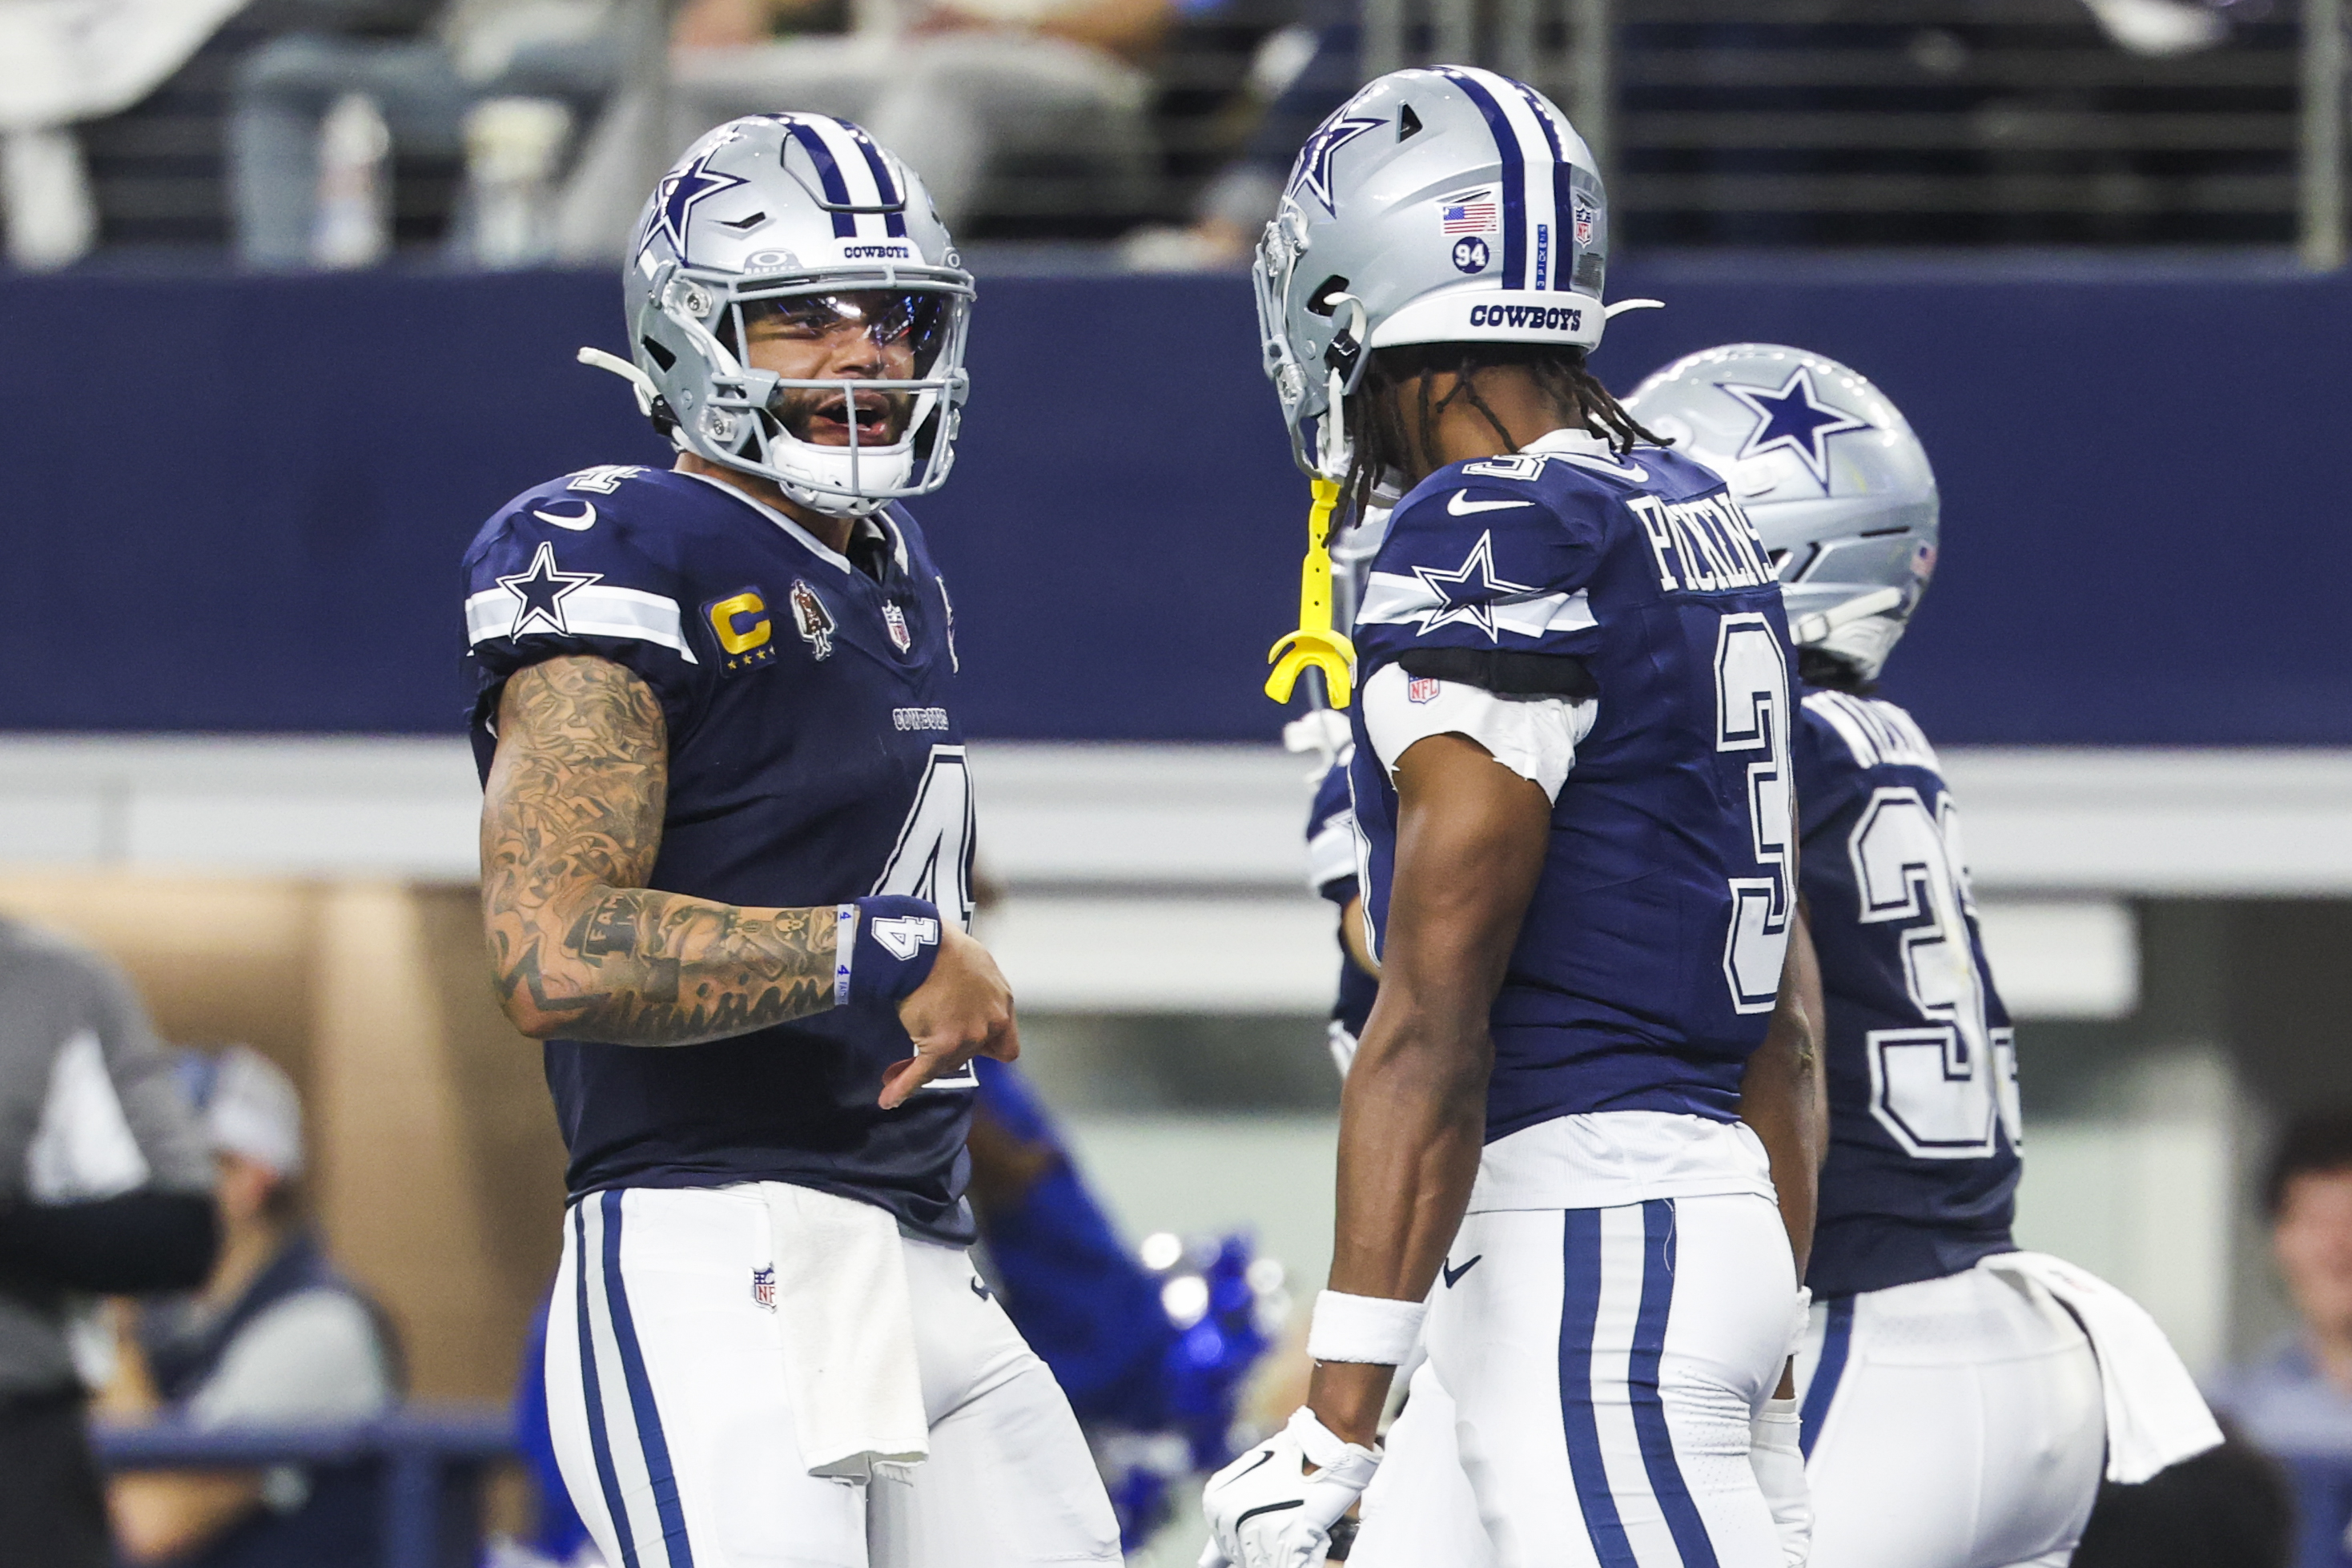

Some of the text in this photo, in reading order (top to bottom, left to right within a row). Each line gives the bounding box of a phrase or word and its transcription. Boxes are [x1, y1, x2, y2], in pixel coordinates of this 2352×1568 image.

[1455, 243, 1486, 267] 94
[1470, 305, 1582, 332] COWBOYS
[710, 592, 772, 655] C
[1412, 678, 1437, 699] NFL
[1715, 612, 1798, 1015] 3
[871, 915, 939, 961] 4
